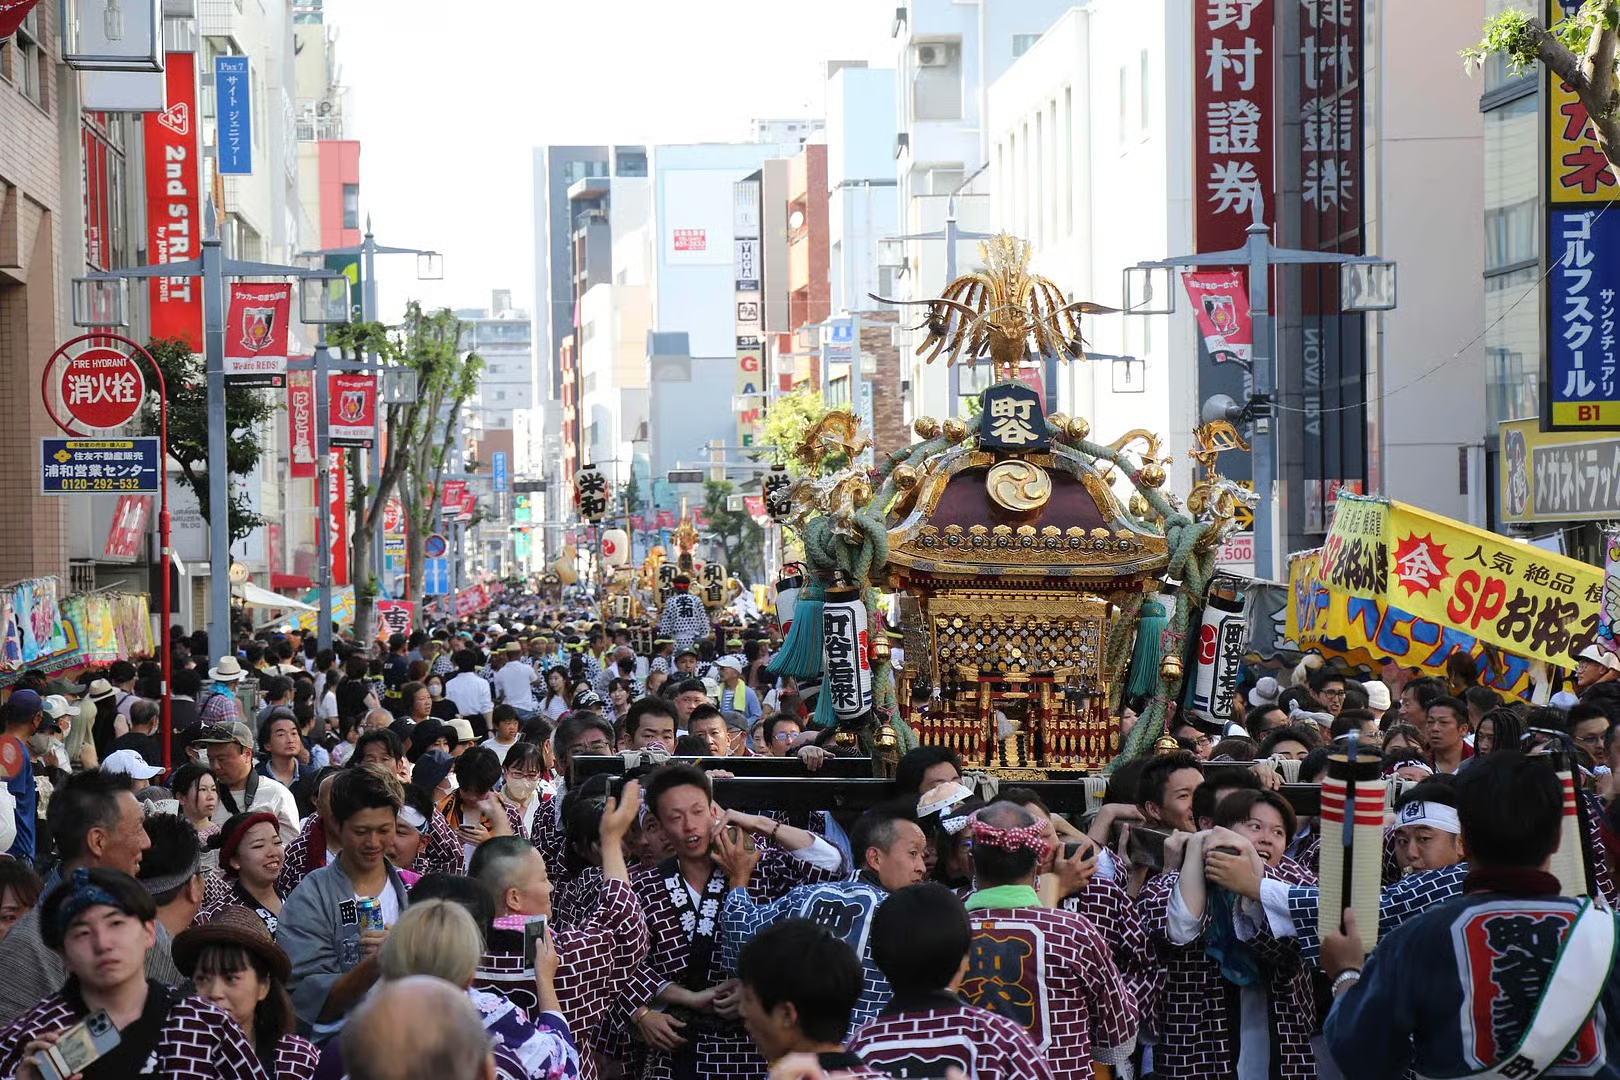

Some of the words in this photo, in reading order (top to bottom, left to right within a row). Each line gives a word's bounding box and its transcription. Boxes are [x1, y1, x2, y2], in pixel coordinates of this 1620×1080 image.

[221, 62, 237, 71] Pax
[238, 62, 244, 71] 7
[226, 75, 239, 106] サイト
[228, 110, 241, 166] ジェニファー
[165, 145, 187, 196] 2nd
[156, 227, 167, 242] by
[741, 242, 752, 279] YOGA
[1561, 211, 1597, 397] ゴルフスクール
[1599, 288, 1616, 397] サンクチュアリ
[72, 360, 90, 369] FIRE
[92, 358, 127, 368] HYDRANT
[67, 372, 137, 405] 消火栓
[990, 397, 1039, 445] 町谷
[1577, 405, 1601, 422] B1
[45, 464, 155, 478] 浦和営業センター
[73, 451, 144, 461] 住友不動産販売
[61, 478, 139, 490] 0120-292-532
[579, 472, 606, 517] 栄和
[1398, 542, 1439, 589] 金
[1463, 544, 1518, 576] 人気
[1522, 562, 1577, 596] 絶品
